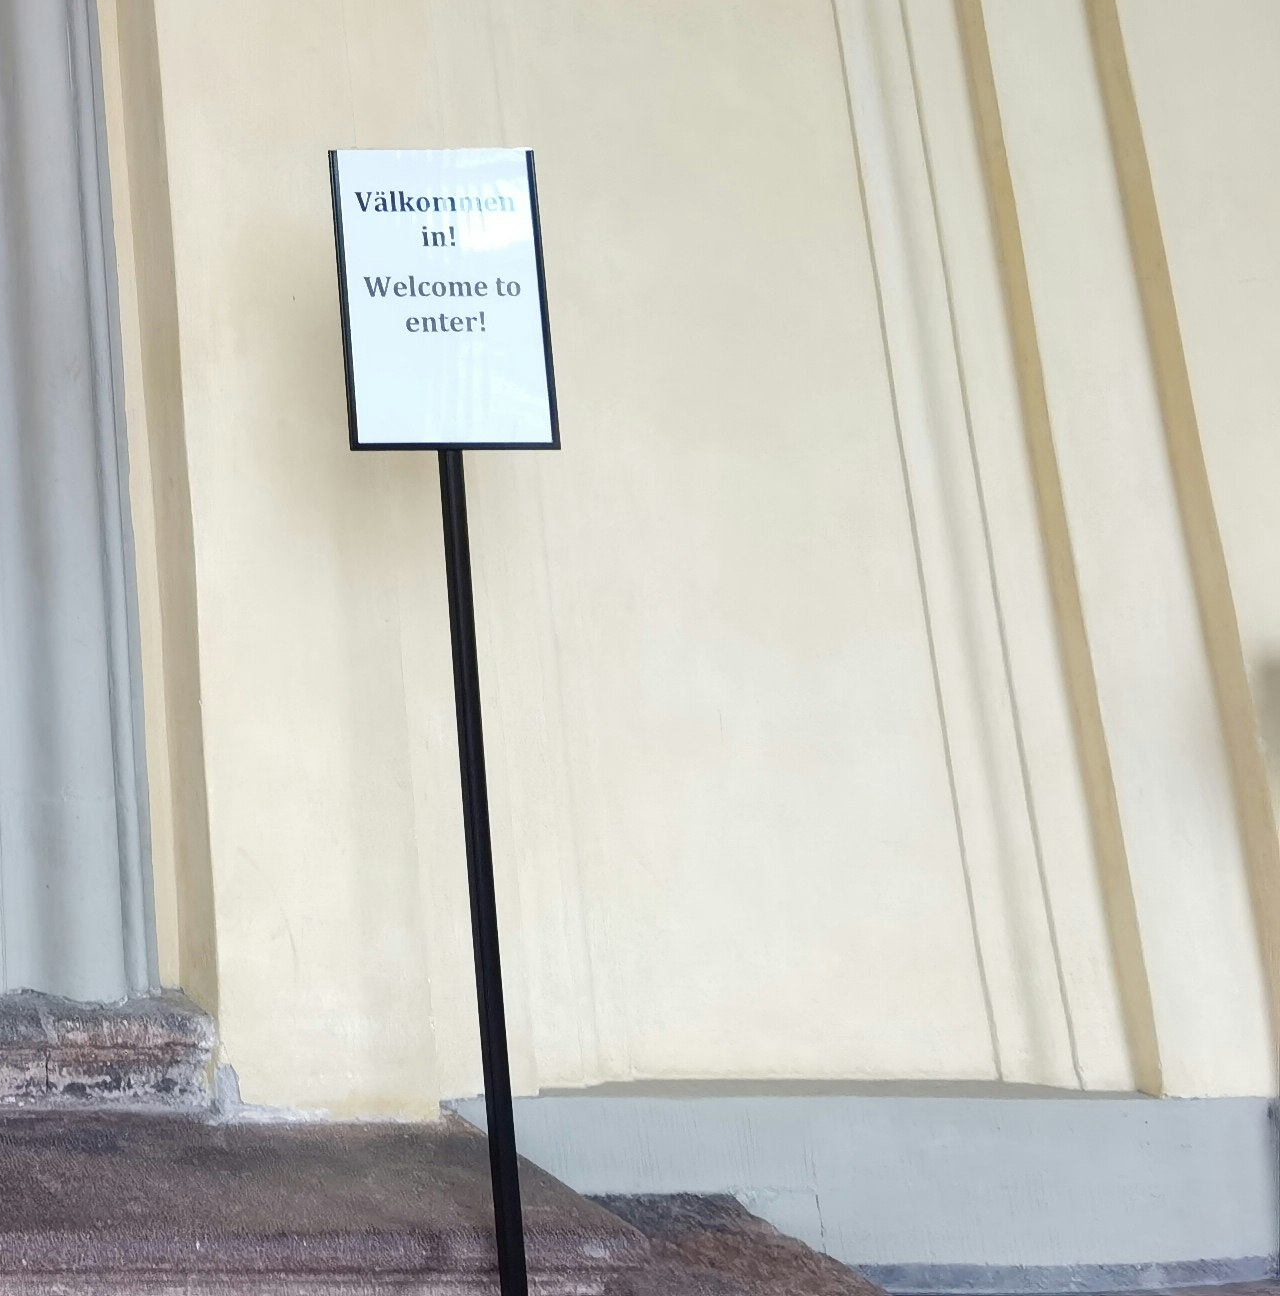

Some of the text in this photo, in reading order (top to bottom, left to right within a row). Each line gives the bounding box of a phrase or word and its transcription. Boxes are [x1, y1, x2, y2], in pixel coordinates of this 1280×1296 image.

[354, 190, 516, 213] Välkommen
[421, 226, 457, 248] in!
[363, 275, 522, 298] Welcome to
[404, 311, 487, 334] enter!
